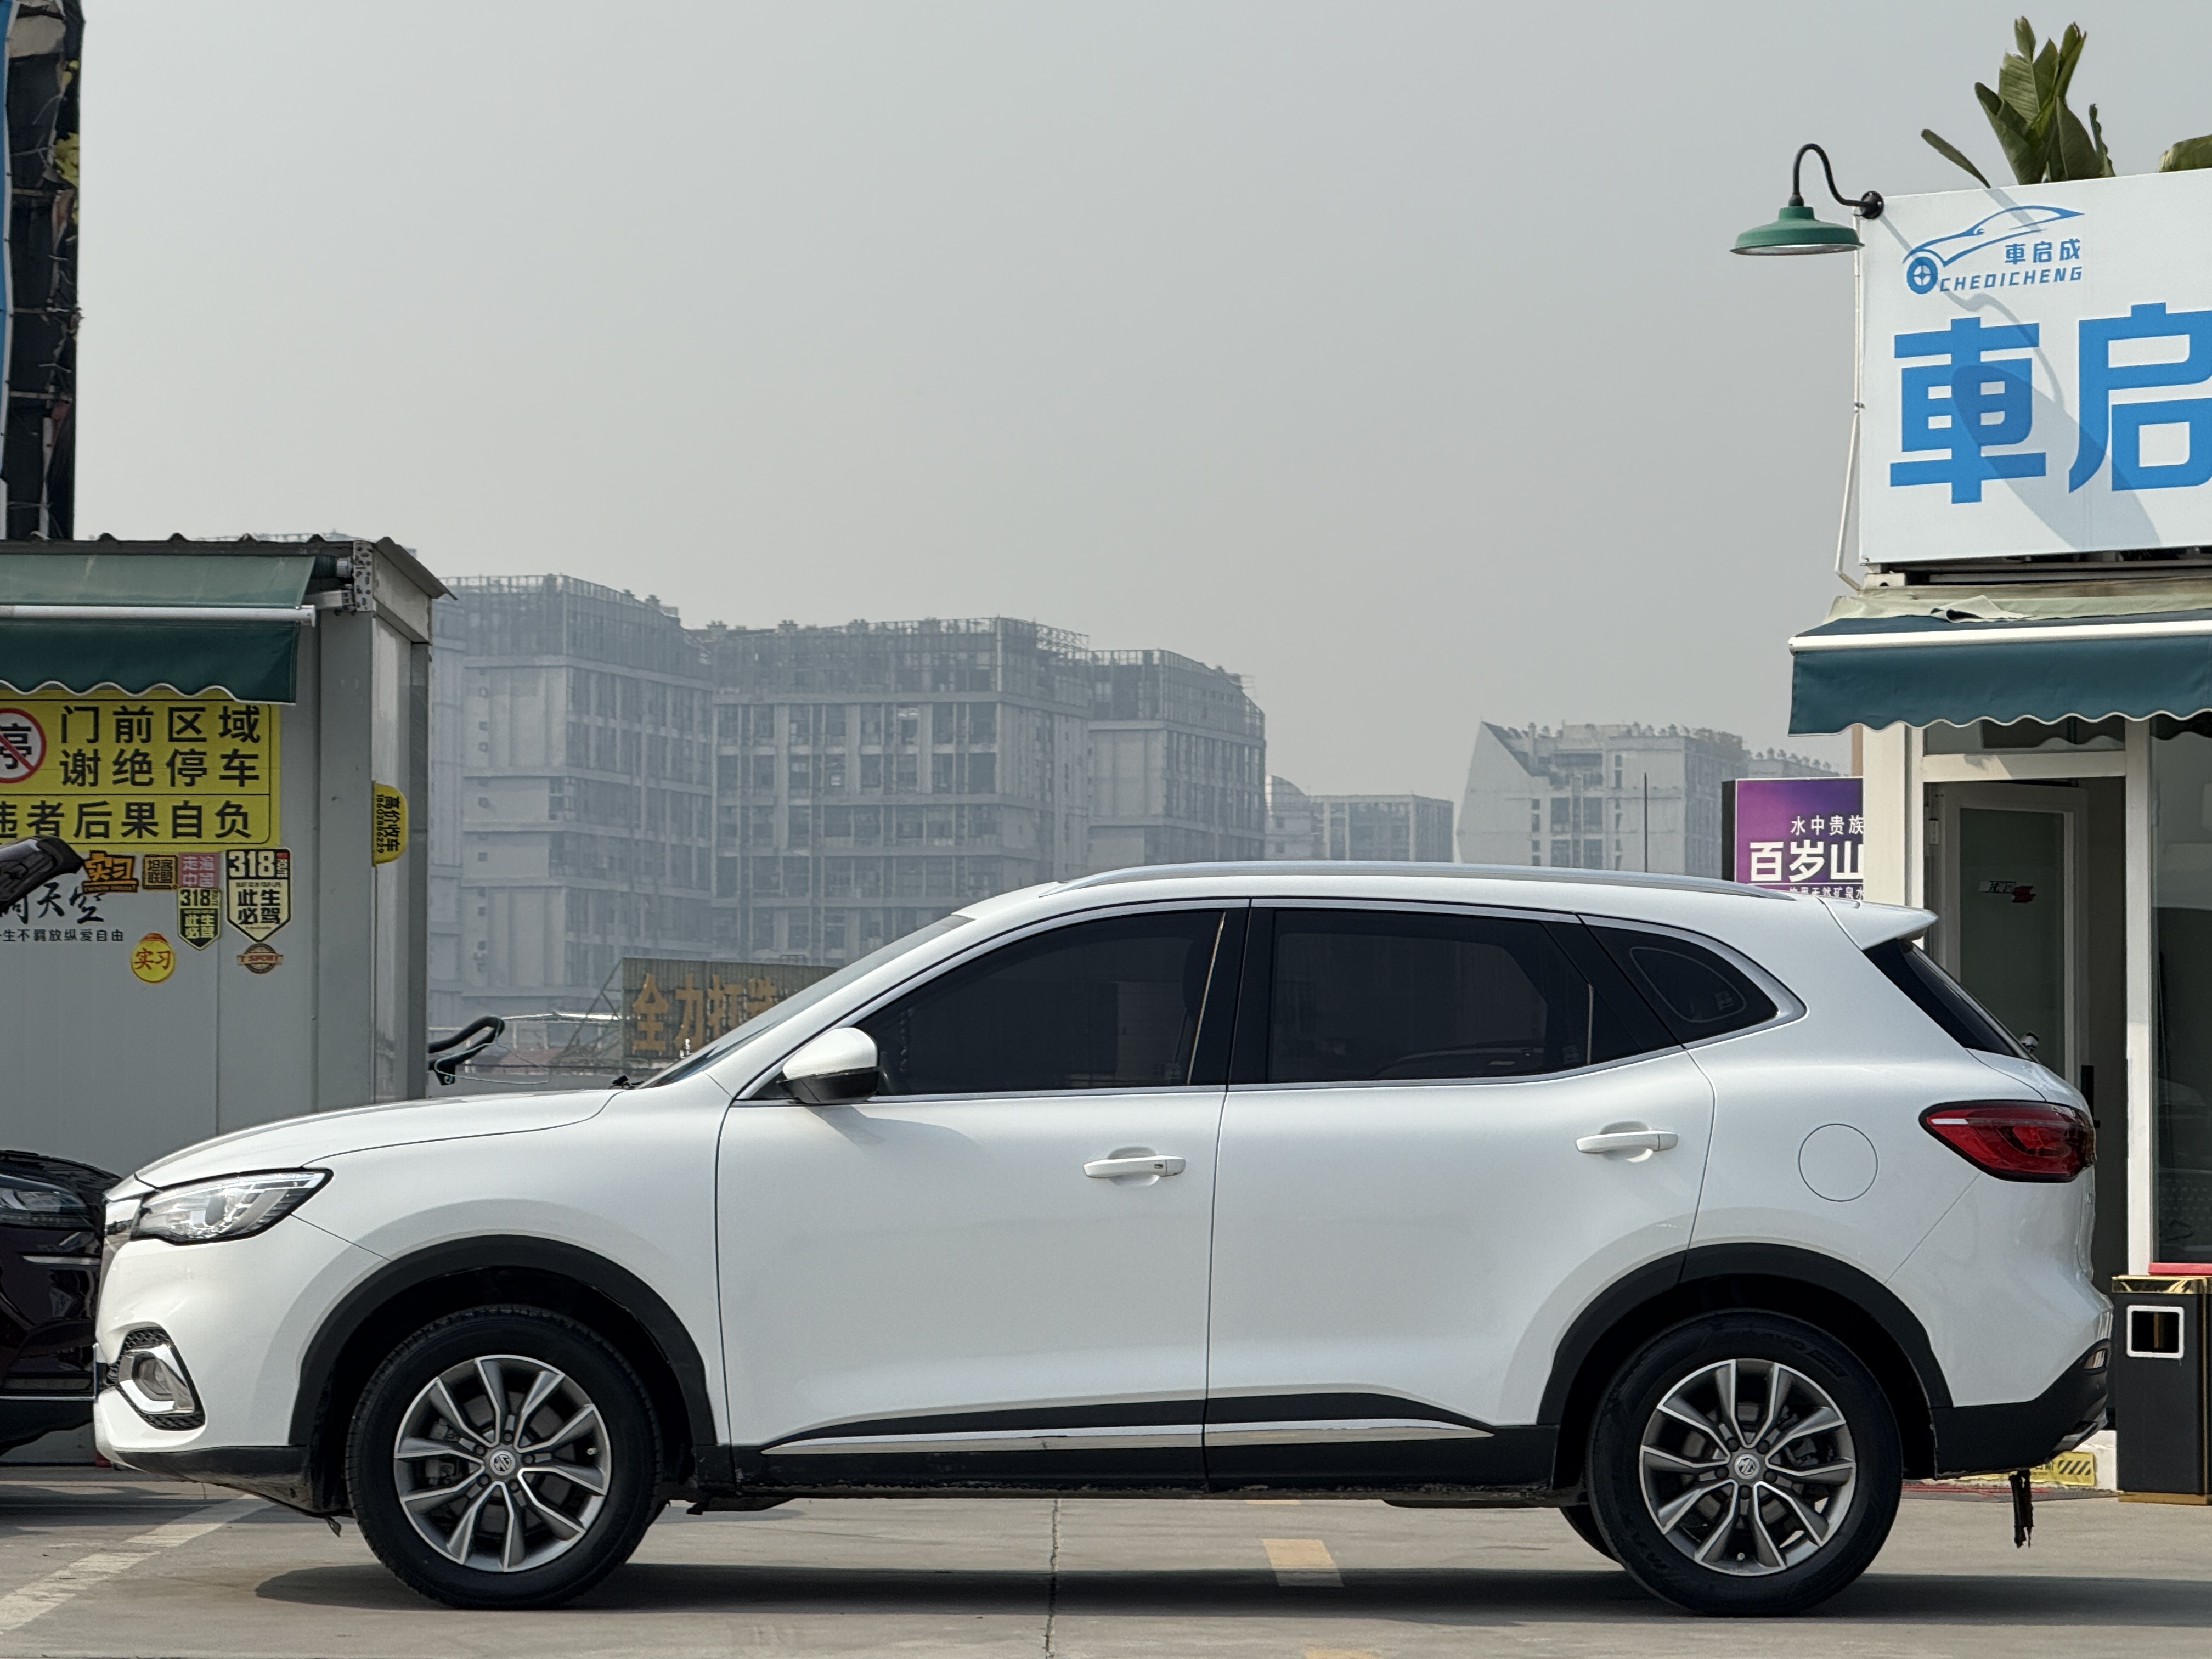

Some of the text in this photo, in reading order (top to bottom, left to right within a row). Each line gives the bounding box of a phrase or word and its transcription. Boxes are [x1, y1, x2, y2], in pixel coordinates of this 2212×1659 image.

[2005, 238, 2081, 265] 車启成
[1889, 302, 2212, 504] 車启
[60, 704, 261, 744] 门前区域
[60, 748, 260, 788] 谢绝停车
[1790, 815, 1864, 836] 水中贵族
[84, 852, 133, 881] 实习
[228, 850, 275, 877] 318
[1749, 839, 1864, 882] 百岁山
[182, 872, 215, 887] 中国
[180, 889, 211, 906] 318
[237, 889, 281, 906] 此生
[184, 914, 215, 927] 此生
[237, 907, 281, 925] 必驾
[0, 929, 123, 943] 生不羁放纵爱自由
[133, 948, 171, 970] 实习
